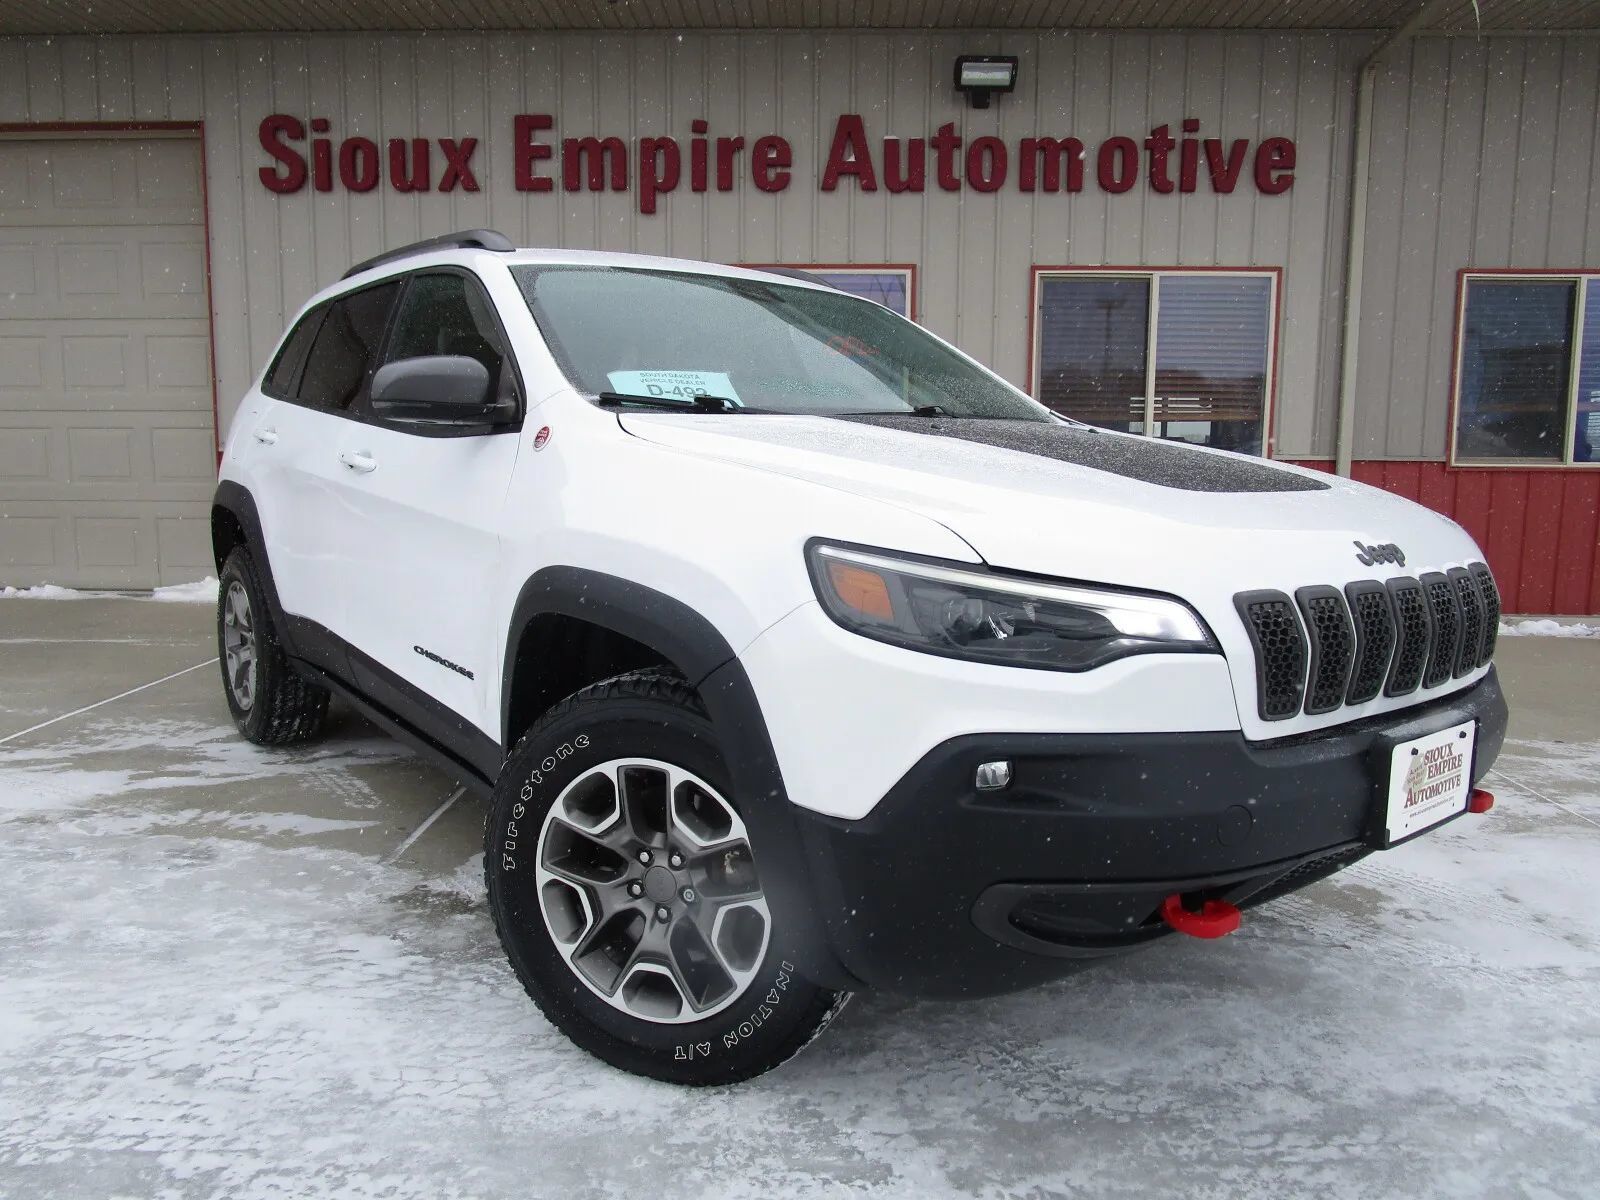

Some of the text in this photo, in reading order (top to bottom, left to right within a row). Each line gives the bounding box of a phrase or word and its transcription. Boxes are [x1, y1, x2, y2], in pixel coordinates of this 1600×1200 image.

[258, 114, 1297, 214] Sioux Empire Automotive
[1353, 540, 1406, 567] Jeep
[413, 645, 475, 680] CHEROKEE
[1423, 742, 1454, 766] SIOUX
[1427, 753, 1464, 780] EMPIRE
[503, 735, 590, 871] Firestone
